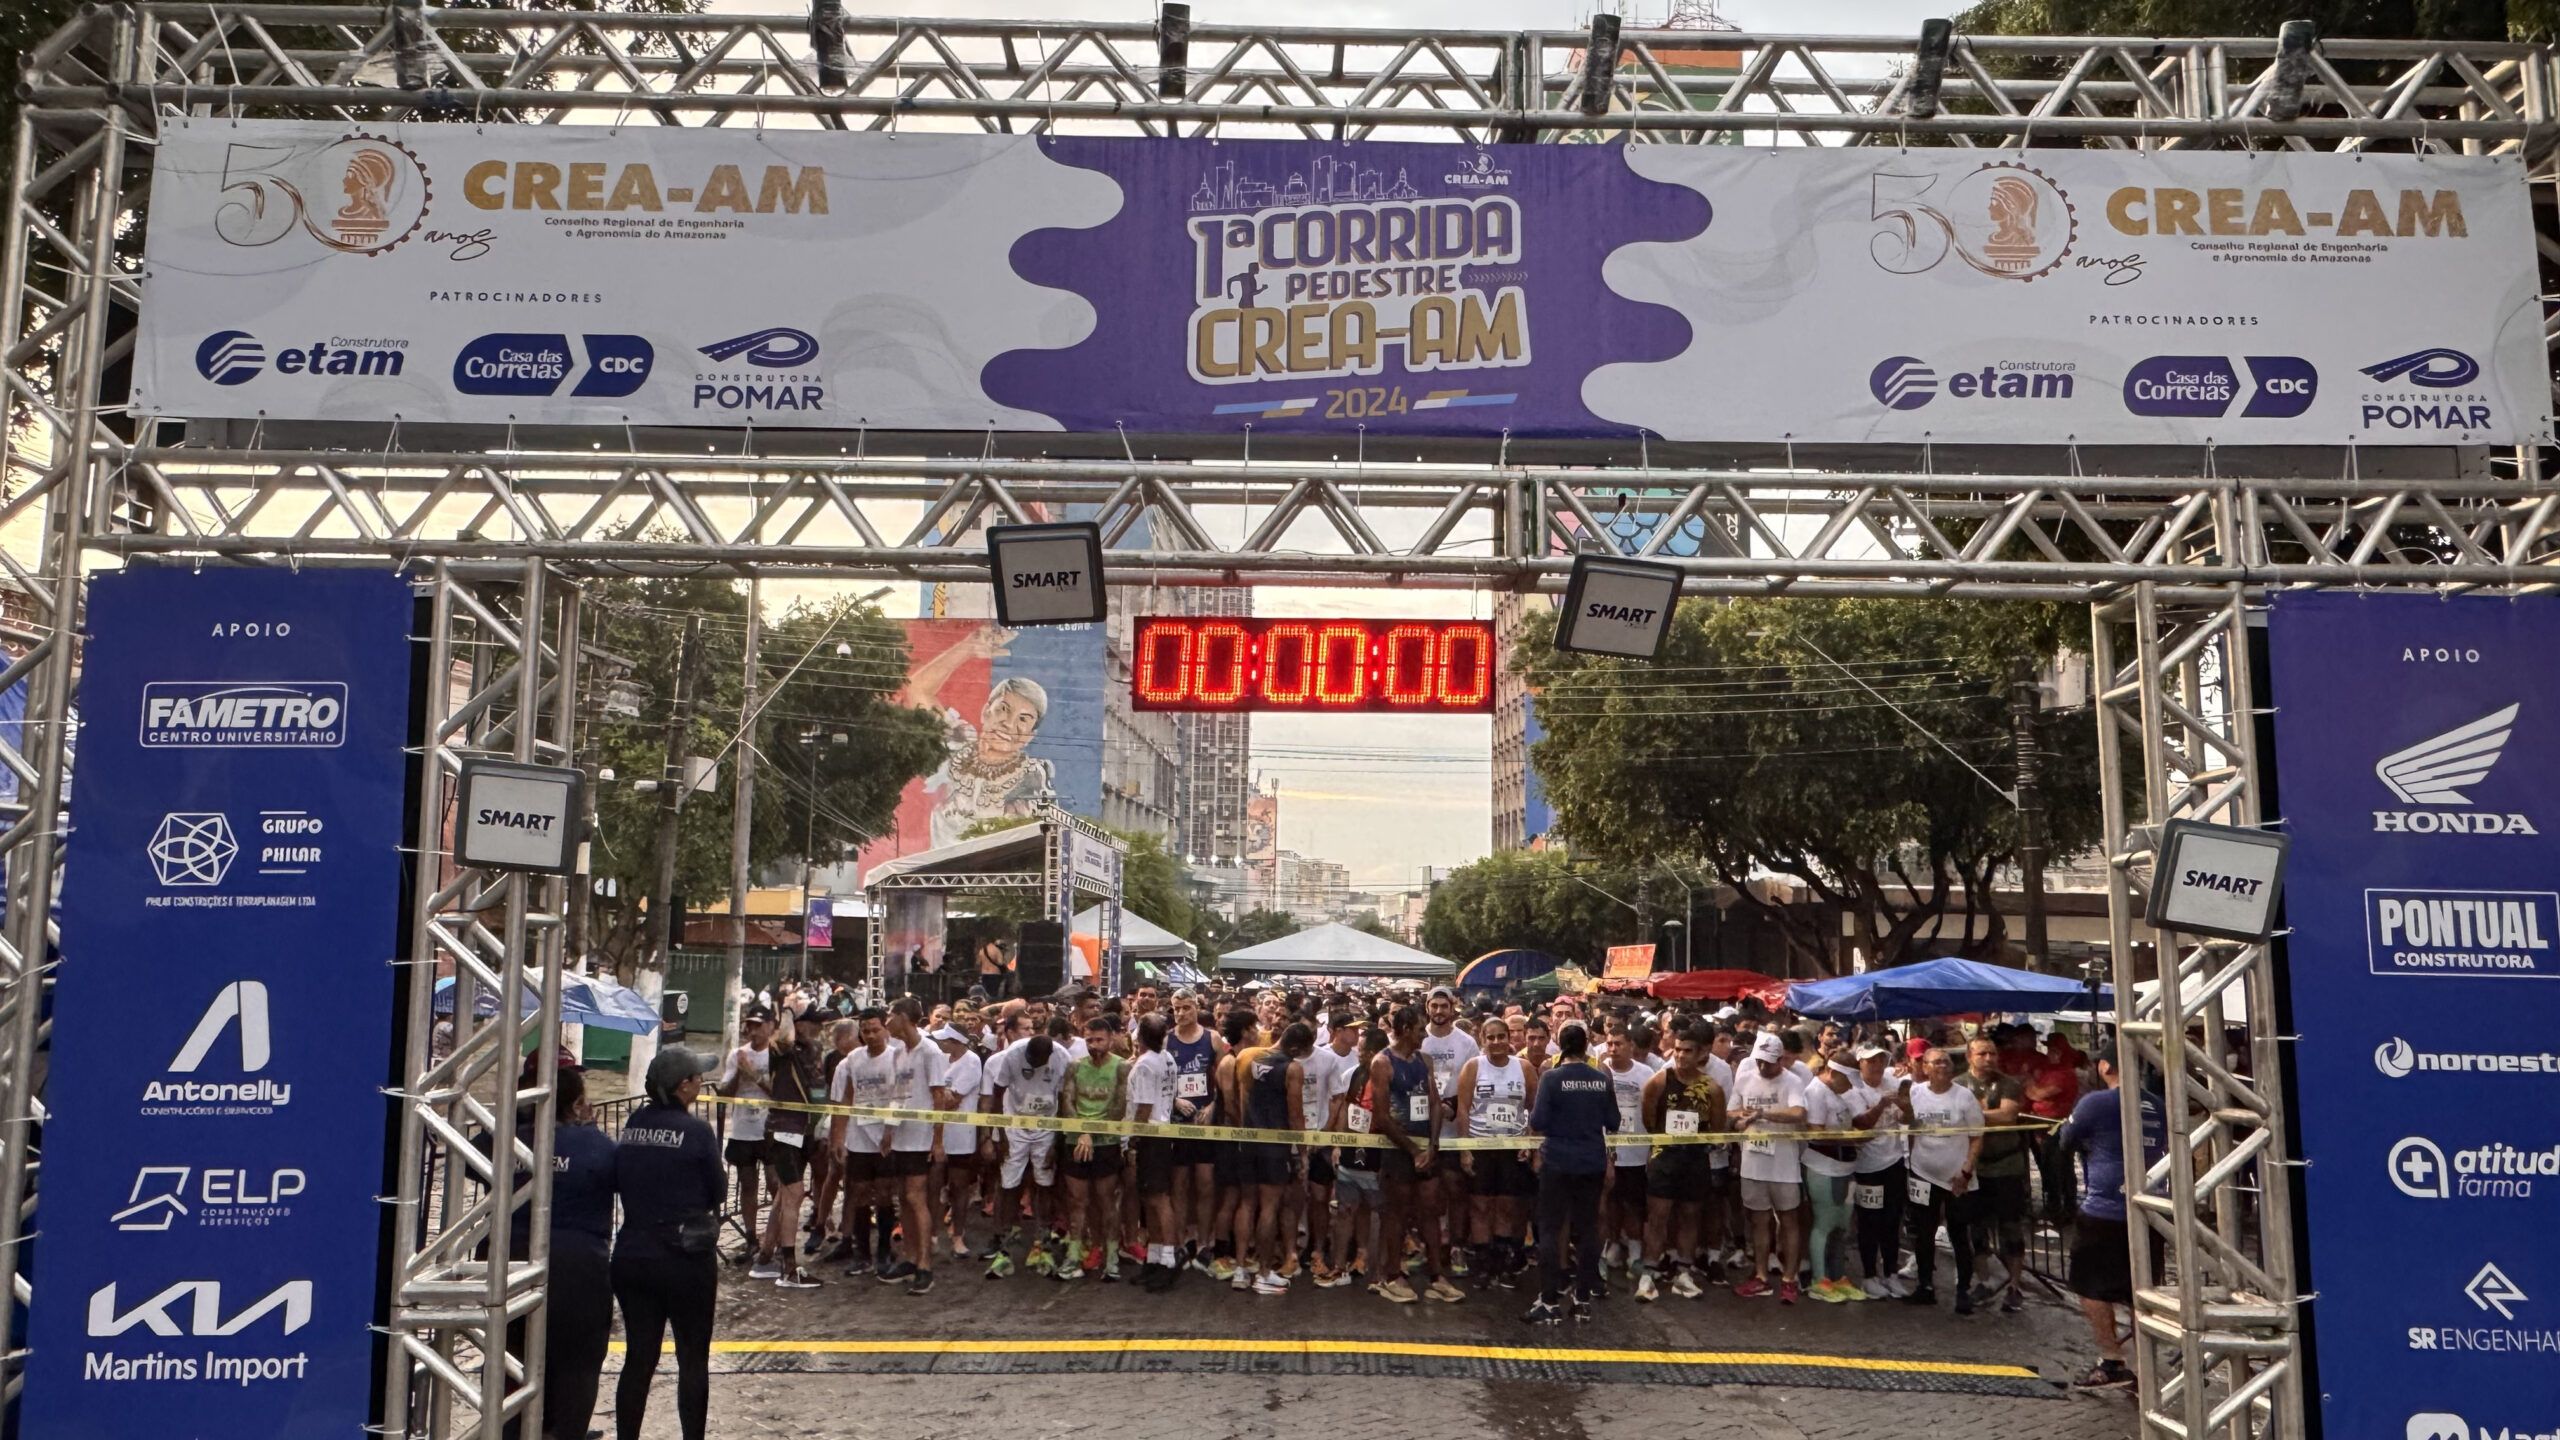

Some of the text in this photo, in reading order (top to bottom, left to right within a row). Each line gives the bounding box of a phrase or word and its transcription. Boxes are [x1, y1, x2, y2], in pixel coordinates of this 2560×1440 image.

[463, 159, 829, 214] CREA-AM
[1444, 174, 1509, 185] CREA-AM
[2105, 187, 2468, 237] CREA-AM
[544, 217, 744, 231] Conselho Regional de Engenharia
[576, 229, 641, 241] Agronomia
[645, 230, 661, 239] do
[664, 230, 726, 240] Amazonas
[1259, 201, 1514, 269] CORRIDA
[2190, 242, 2388, 254] Conselho Regional de Engenharia
[2223, 253, 2288, 264] Agronomia
[2291, 254, 2306, 263] do
[2310, 254, 2371, 263] Amazonas
[1286, 264, 1456, 303] PEDESTRE
[430, 292, 602, 304] PATROCINADORES
[2089, 315, 2259, 326] PATROCINADORES
[331, 336, 409, 349] Construtora
[1196, 292, 1522, 378] CREA-AM
[276, 343, 405, 376] etam
[499, 349, 562, 363] Casa das
[600, 357, 644, 374] CDC
[1999, 360, 2076, 372] Construtora
[465, 356, 563, 379] Correias
[695, 374, 823, 383] CONSTRUTORA
[2166, 371, 2228, 384] Casa das
[1949, 366, 2074, 398] etam
[2134, 377, 2230, 401] Correias
[2265, 378, 2309, 394] CDC
[693, 384, 824, 411] POMAR
[1325, 387, 1407, 419] 2024
[2362, 394, 2488, 402] CONSTRUTORA
[2362, 405, 2491, 430] POMAR
[1012, 571, 1081, 589] SMART
[1586, 603, 1657, 624] SMART
[212, 622, 292, 638] APOIO
[1138, 622, 1490, 706] 00:00:00
[2402, 648, 2480, 663] APOIO
[148, 696, 339, 729] FAMETRO
[149, 729, 336, 743] CENTRO UNIVERSITÁRIO
[262, 818, 323, 835] GRUPO
[477, 808, 556, 832] SMART
[2372, 811, 2539, 835] HONDA
[262, 846, 321, 863] PHILAR
[2183, 870, 2264, 895] SMART
[2379, 898, 2549, 950] PONTUAL
[2393, 952, 2535, 969] CONSTRUTORA
[2417, 1052, 2560, 1073] noroest
[143, 1079, 291, 1105] Antonelly
[203, 1168, 306, 1204] ELP
[2458, 1173, 2531, 1198] farma
[87, 1280, 313, 1337] KIA
[2408, 1327, 2560, 1352] SR ENGENHA
[85, 1351, 309, 1386] Martins Import
